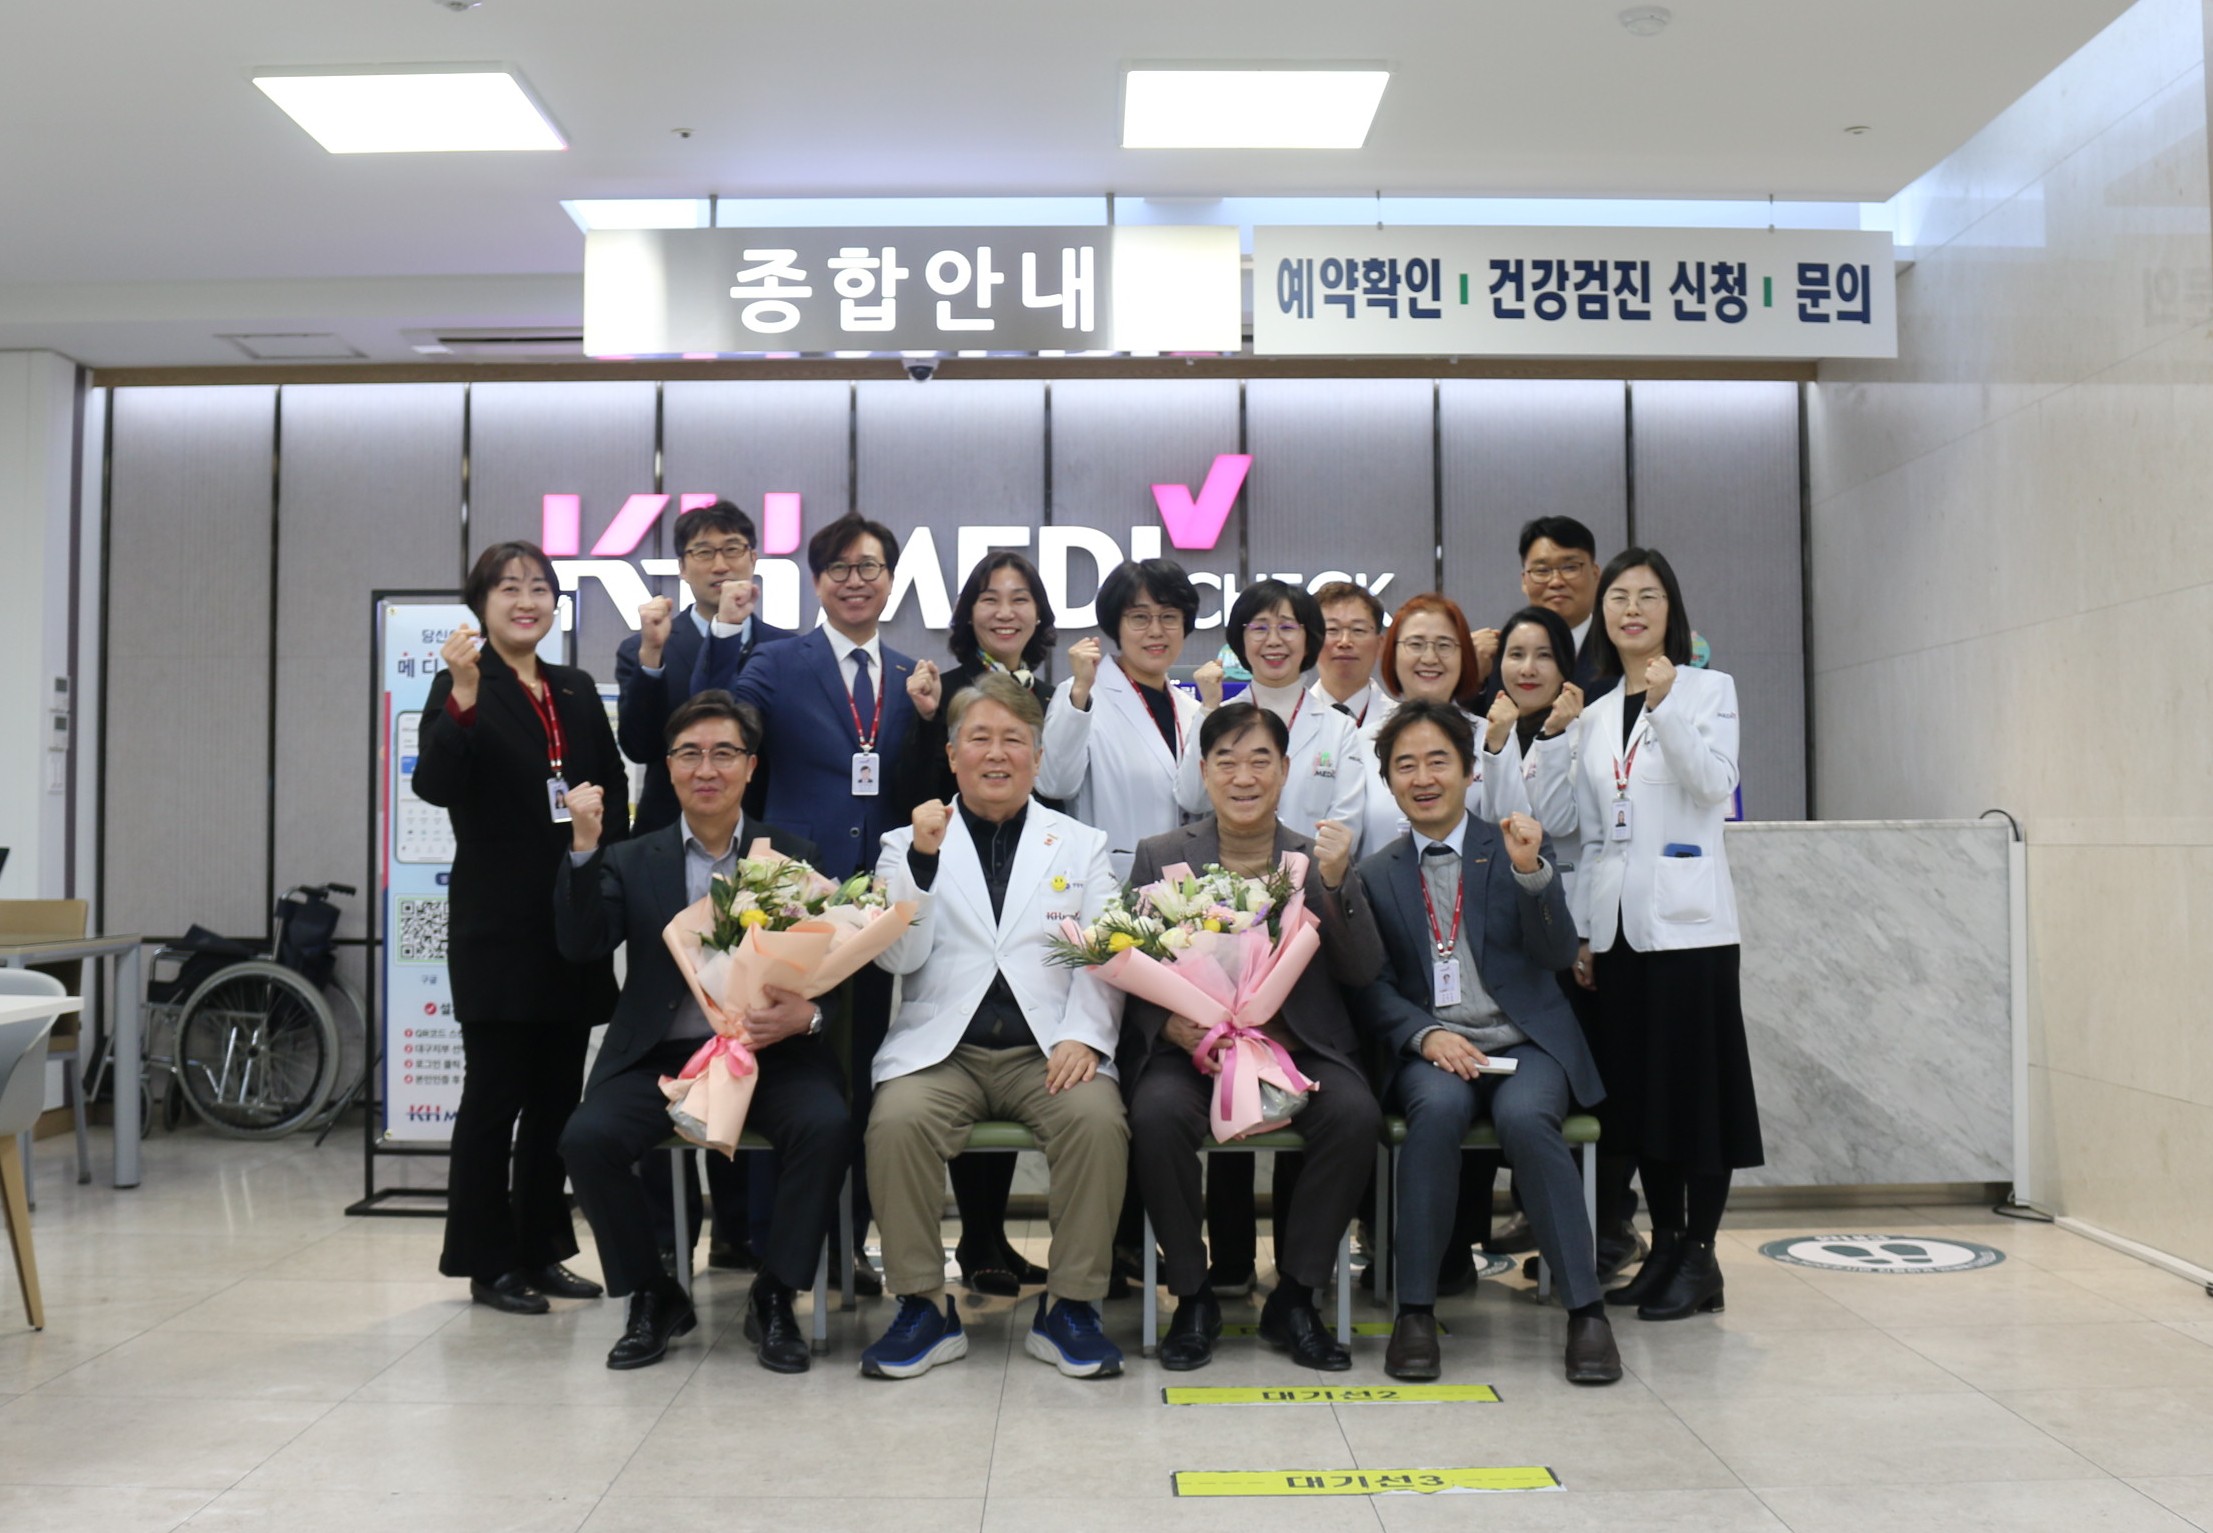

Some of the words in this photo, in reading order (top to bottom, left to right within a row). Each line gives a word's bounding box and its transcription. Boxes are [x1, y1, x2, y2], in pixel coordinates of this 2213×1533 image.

[730, 246, 1094, 333] 종합안내
[1277, 257, 1442, 319] 예약확인
[1488, 258, 1652, 321] 건강검진
[1669, 261, 1748, 323] 신청
[1796, 262, 1871, 324] 문의
[421, 629, 454, 644] 당신
[1262, 1389, 1401, 1401] 대기선2
[1286, 1474, 1445, 1490] 대기선3
